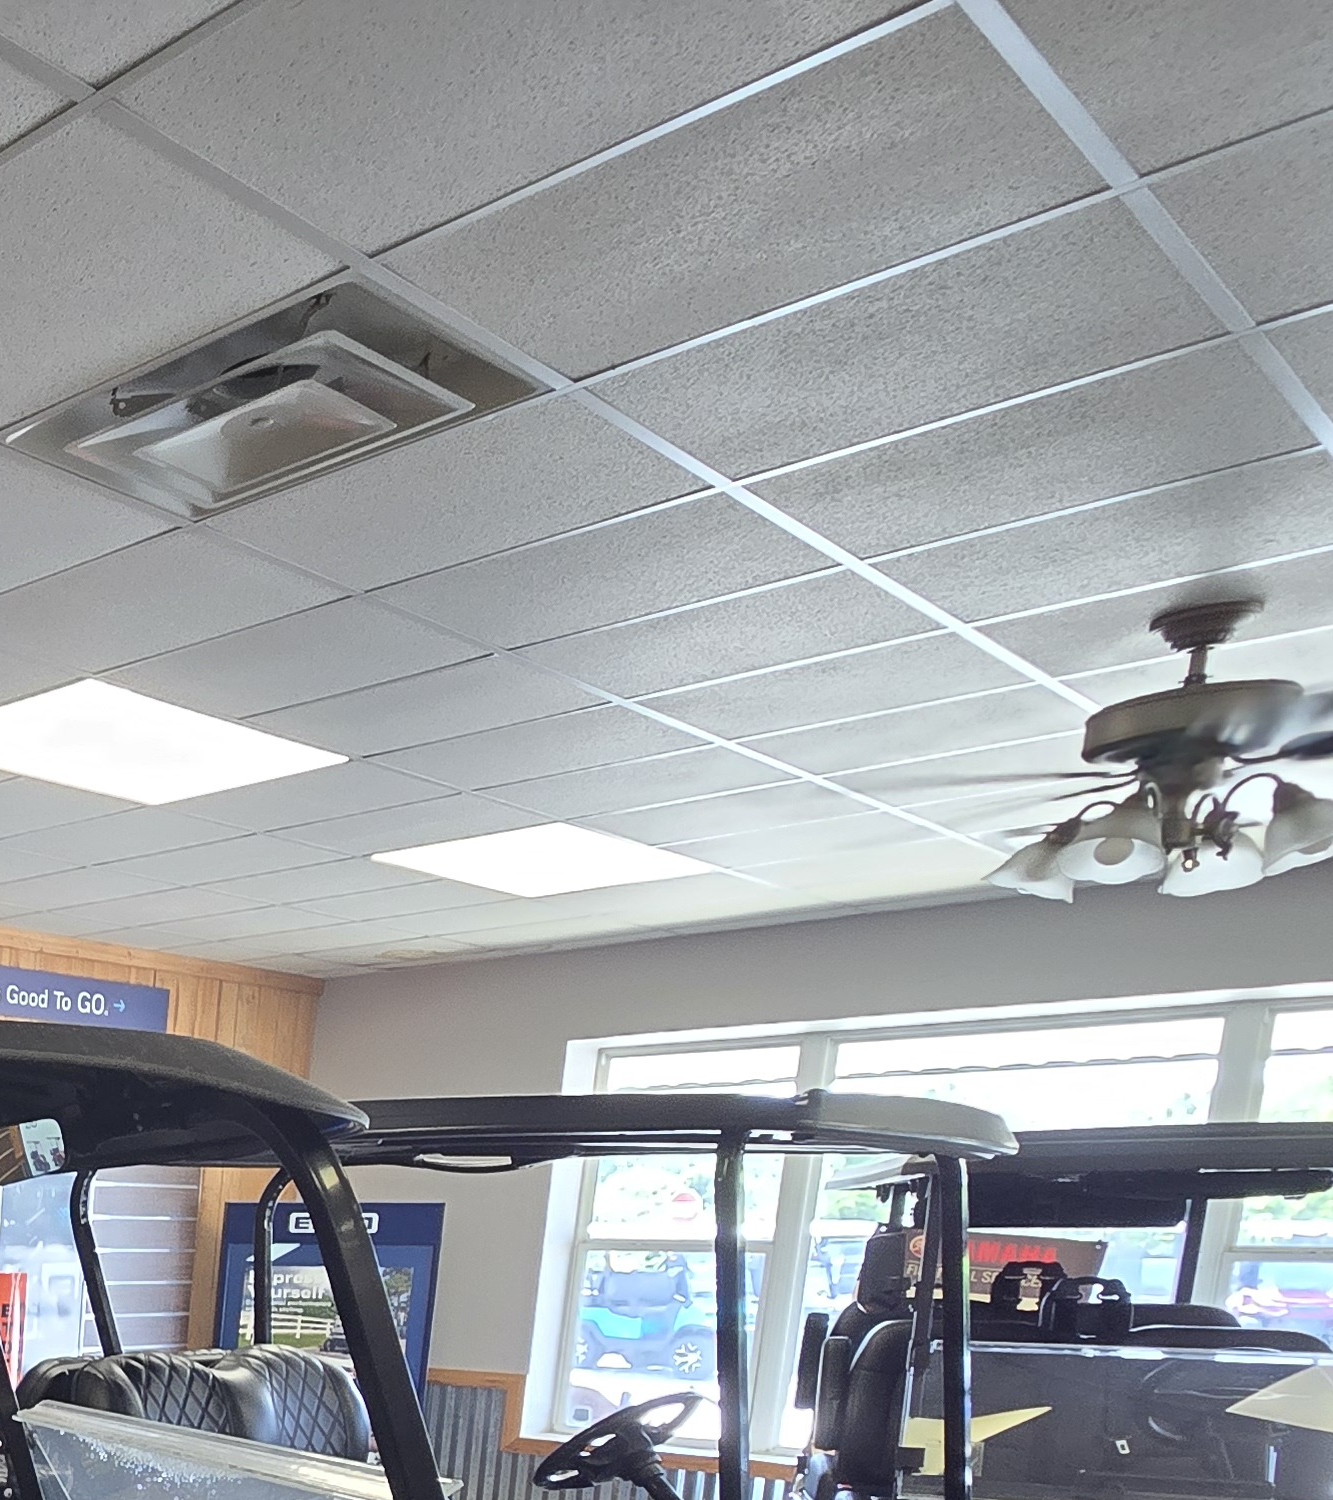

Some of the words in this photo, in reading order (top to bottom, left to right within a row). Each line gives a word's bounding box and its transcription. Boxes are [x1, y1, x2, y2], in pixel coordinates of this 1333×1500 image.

[6, 984, 49, 1009] Good
[53, 990, 72, 1012] To
[77, 991, 109, 1017] GO.
